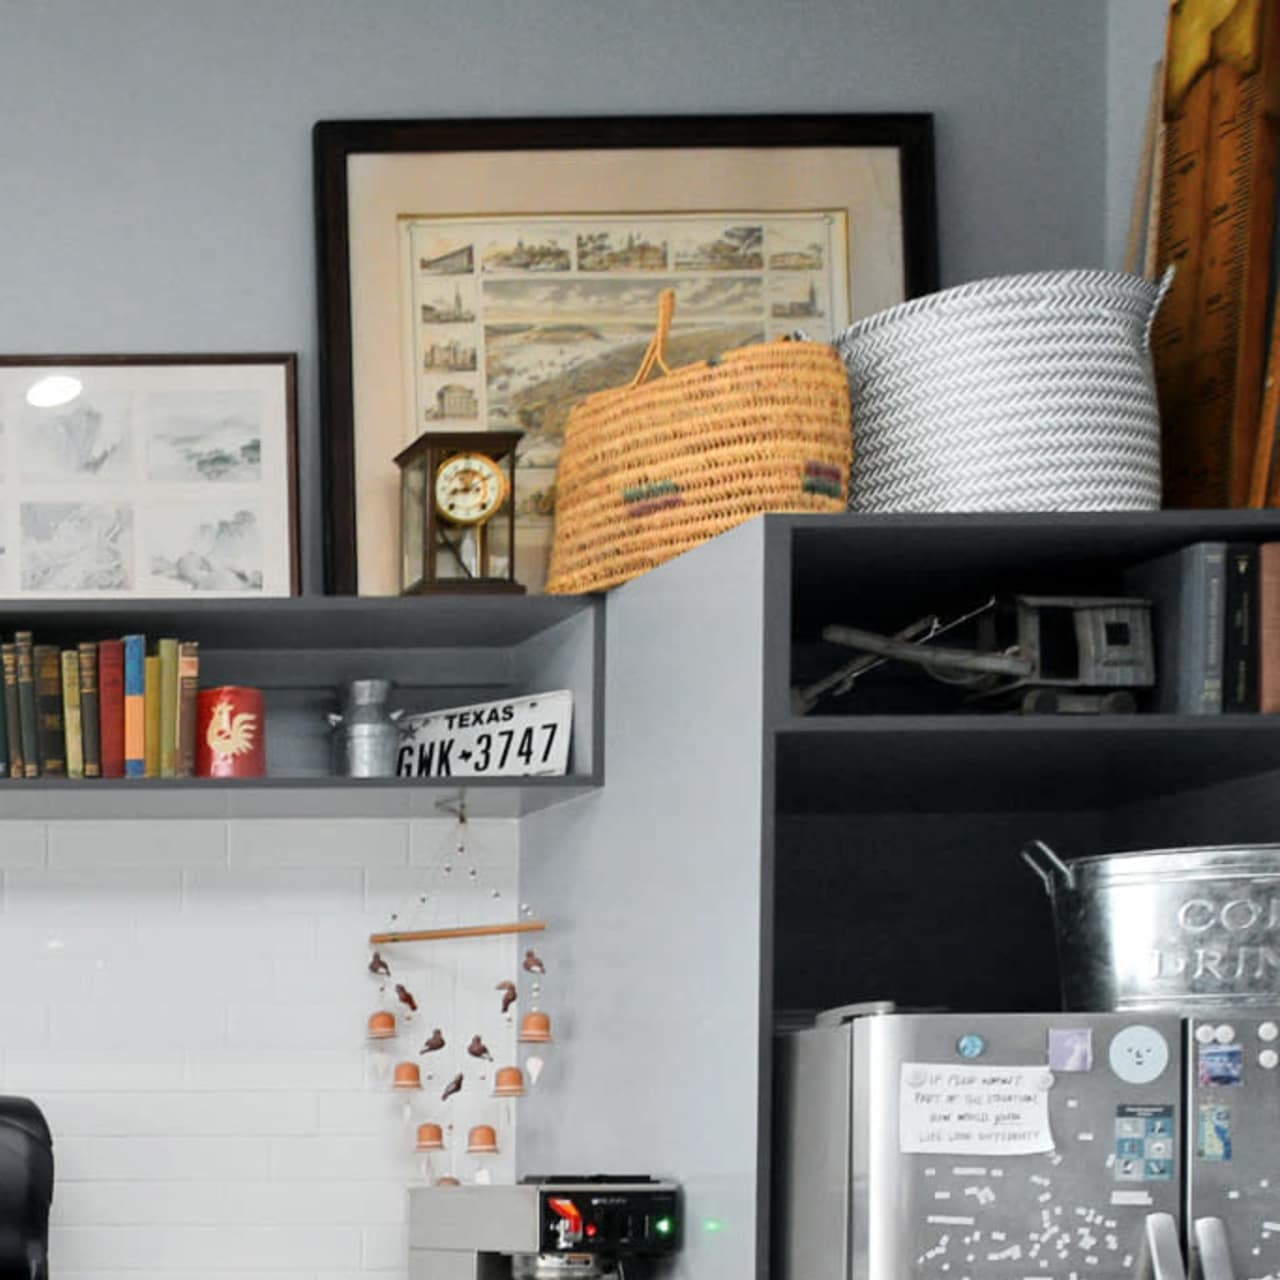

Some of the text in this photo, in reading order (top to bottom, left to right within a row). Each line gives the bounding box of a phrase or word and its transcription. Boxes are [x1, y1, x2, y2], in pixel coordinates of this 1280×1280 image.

[444, 704, 515, 731] TEXAS
[396, 722, 558, 777] GWK 3747
